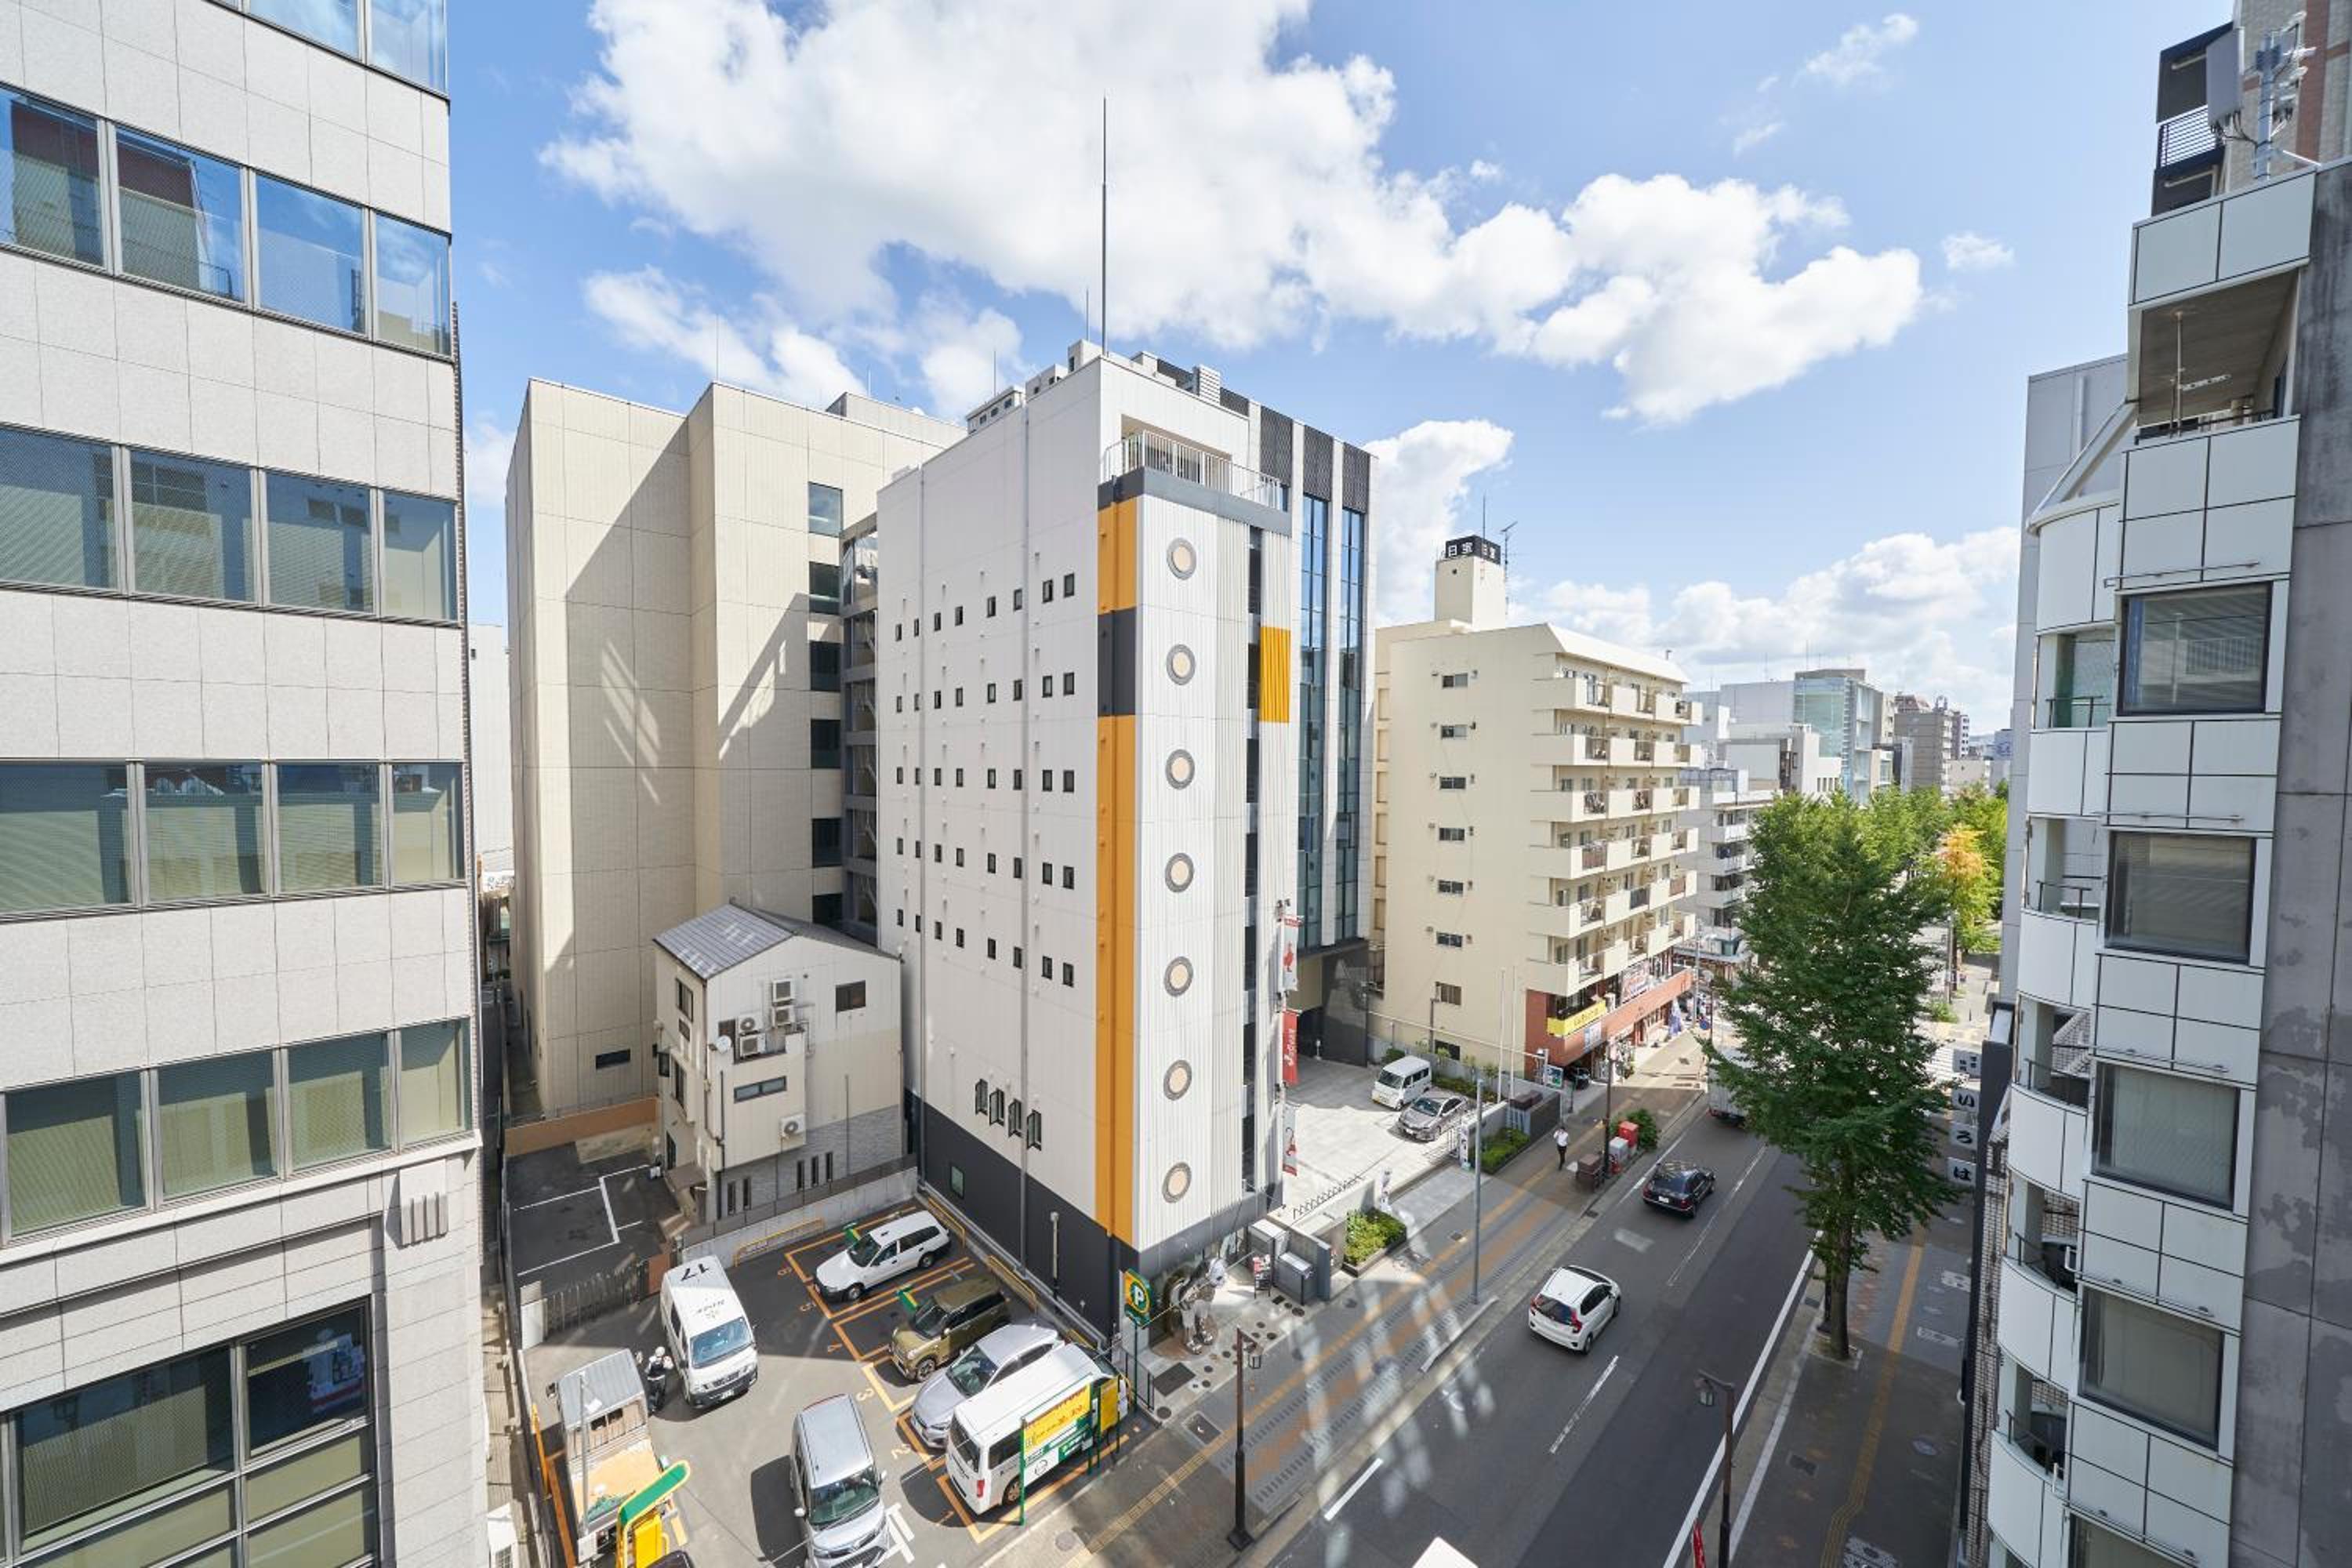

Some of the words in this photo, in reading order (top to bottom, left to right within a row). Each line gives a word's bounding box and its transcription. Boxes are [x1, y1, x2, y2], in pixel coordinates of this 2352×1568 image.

[681, 1263, 710, 1282] 17
[1134, 1285, 1145, 1306] P
[856, 1387, 875, 1403] 3
